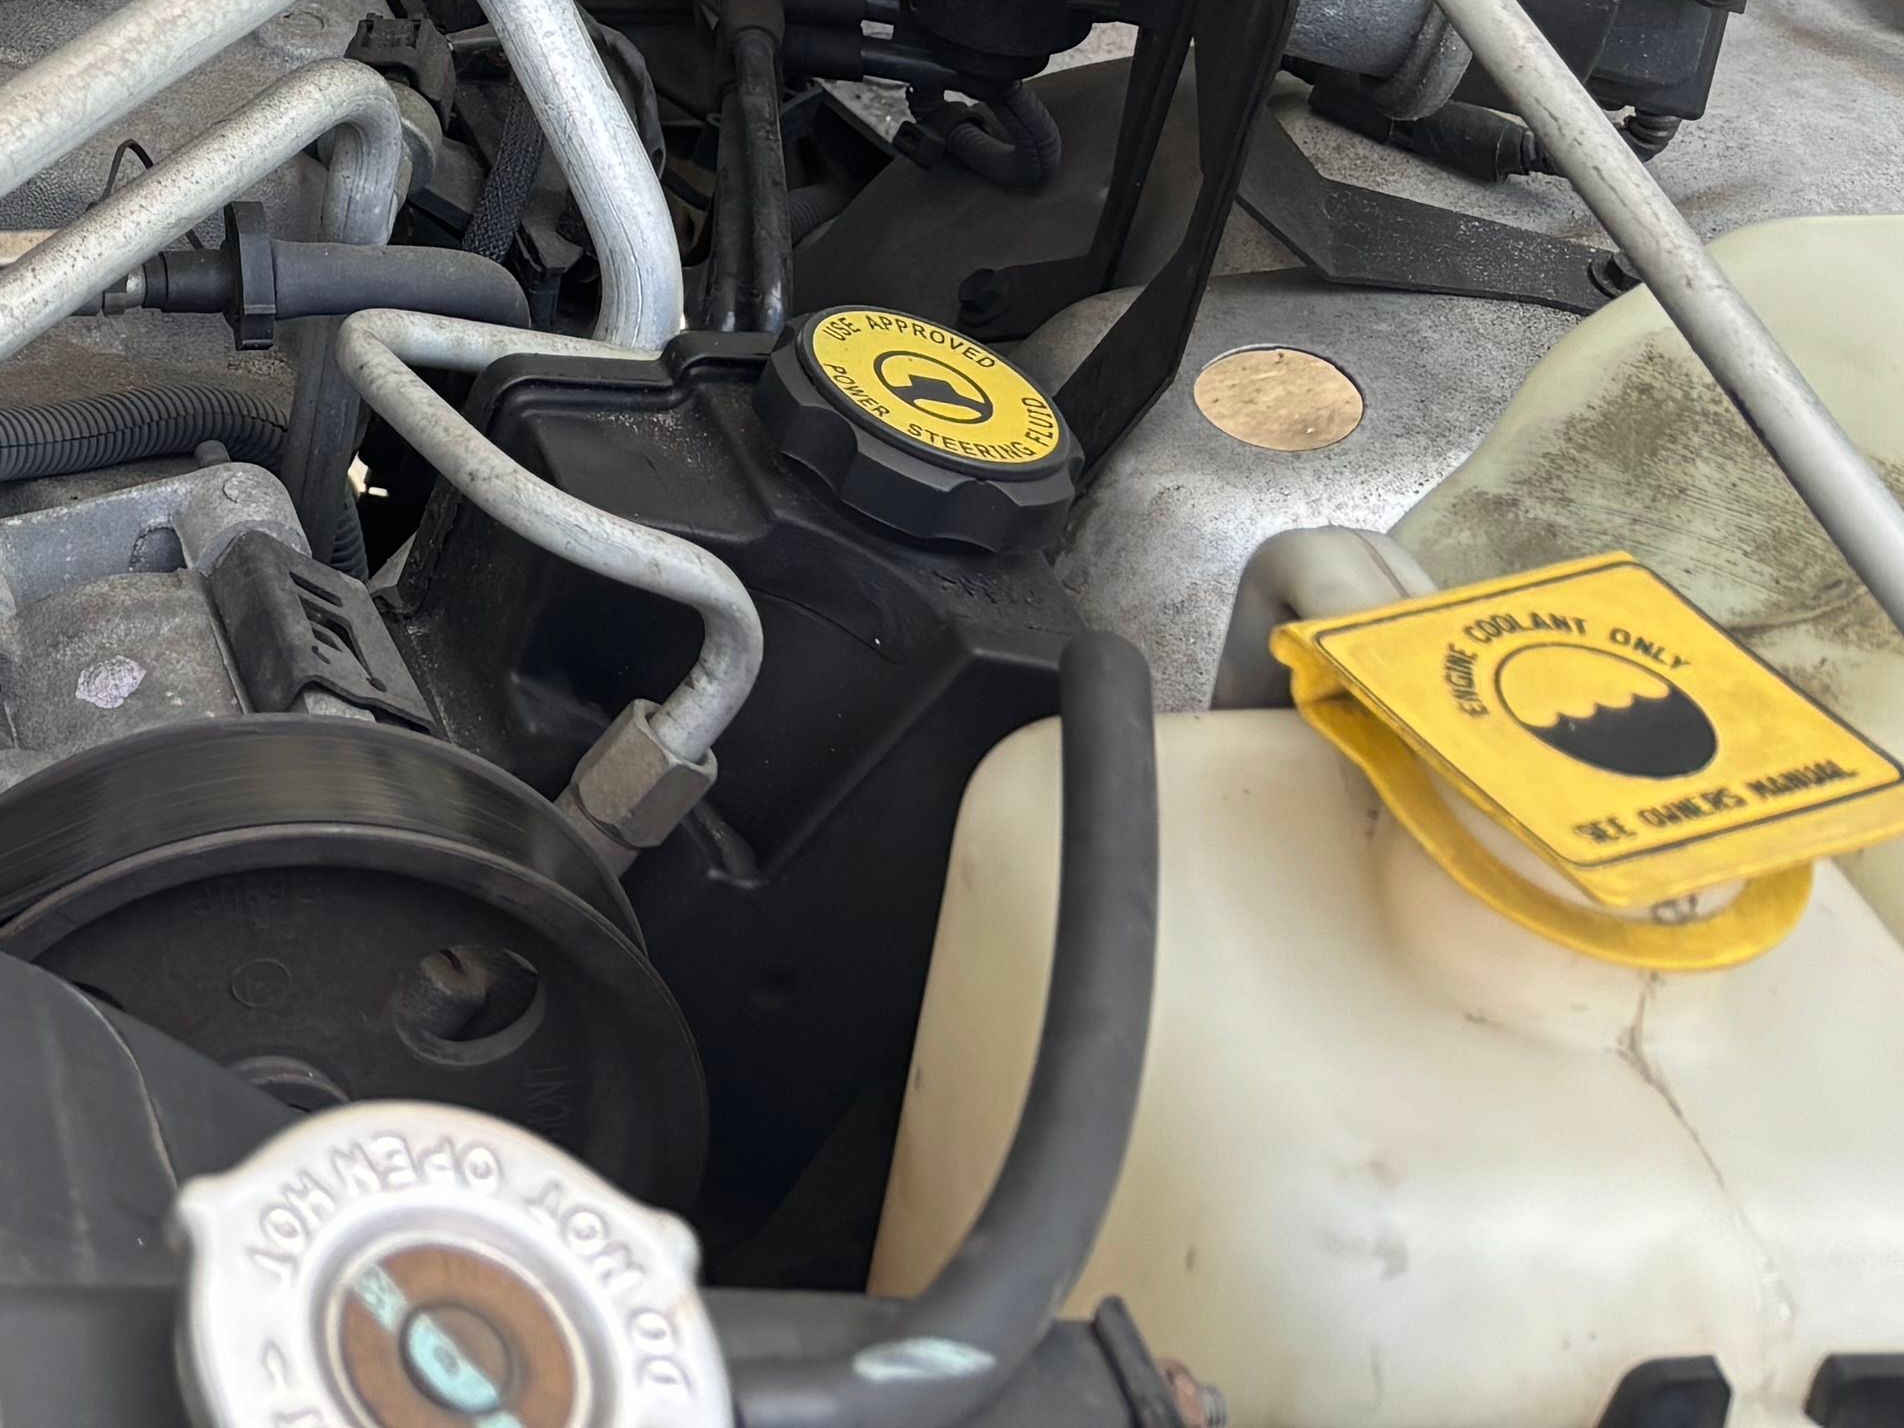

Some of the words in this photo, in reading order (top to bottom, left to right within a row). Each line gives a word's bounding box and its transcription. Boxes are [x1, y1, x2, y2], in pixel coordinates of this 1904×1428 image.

[822, 316, 861, 342] USE
[864, 313, 996, 370] APPROVED
[822, 362, 891, 419] POWER
[906, 423, 1038, 461] STEERING
[1022, 396, 1055, 448] FLUID
[1462, 610, 1589, 646] COOLANT
[1608, 626, 1694, 672] ONLY
[1445, 641, 1490, 720] ENGINE
[1573, 814, 1638, 845] SEE
[1636, 787, 1748, 830] OWNERS
[1745, 758, 1860, 804] MANUAL
[328, 1132, 502, 1198] OPEN
